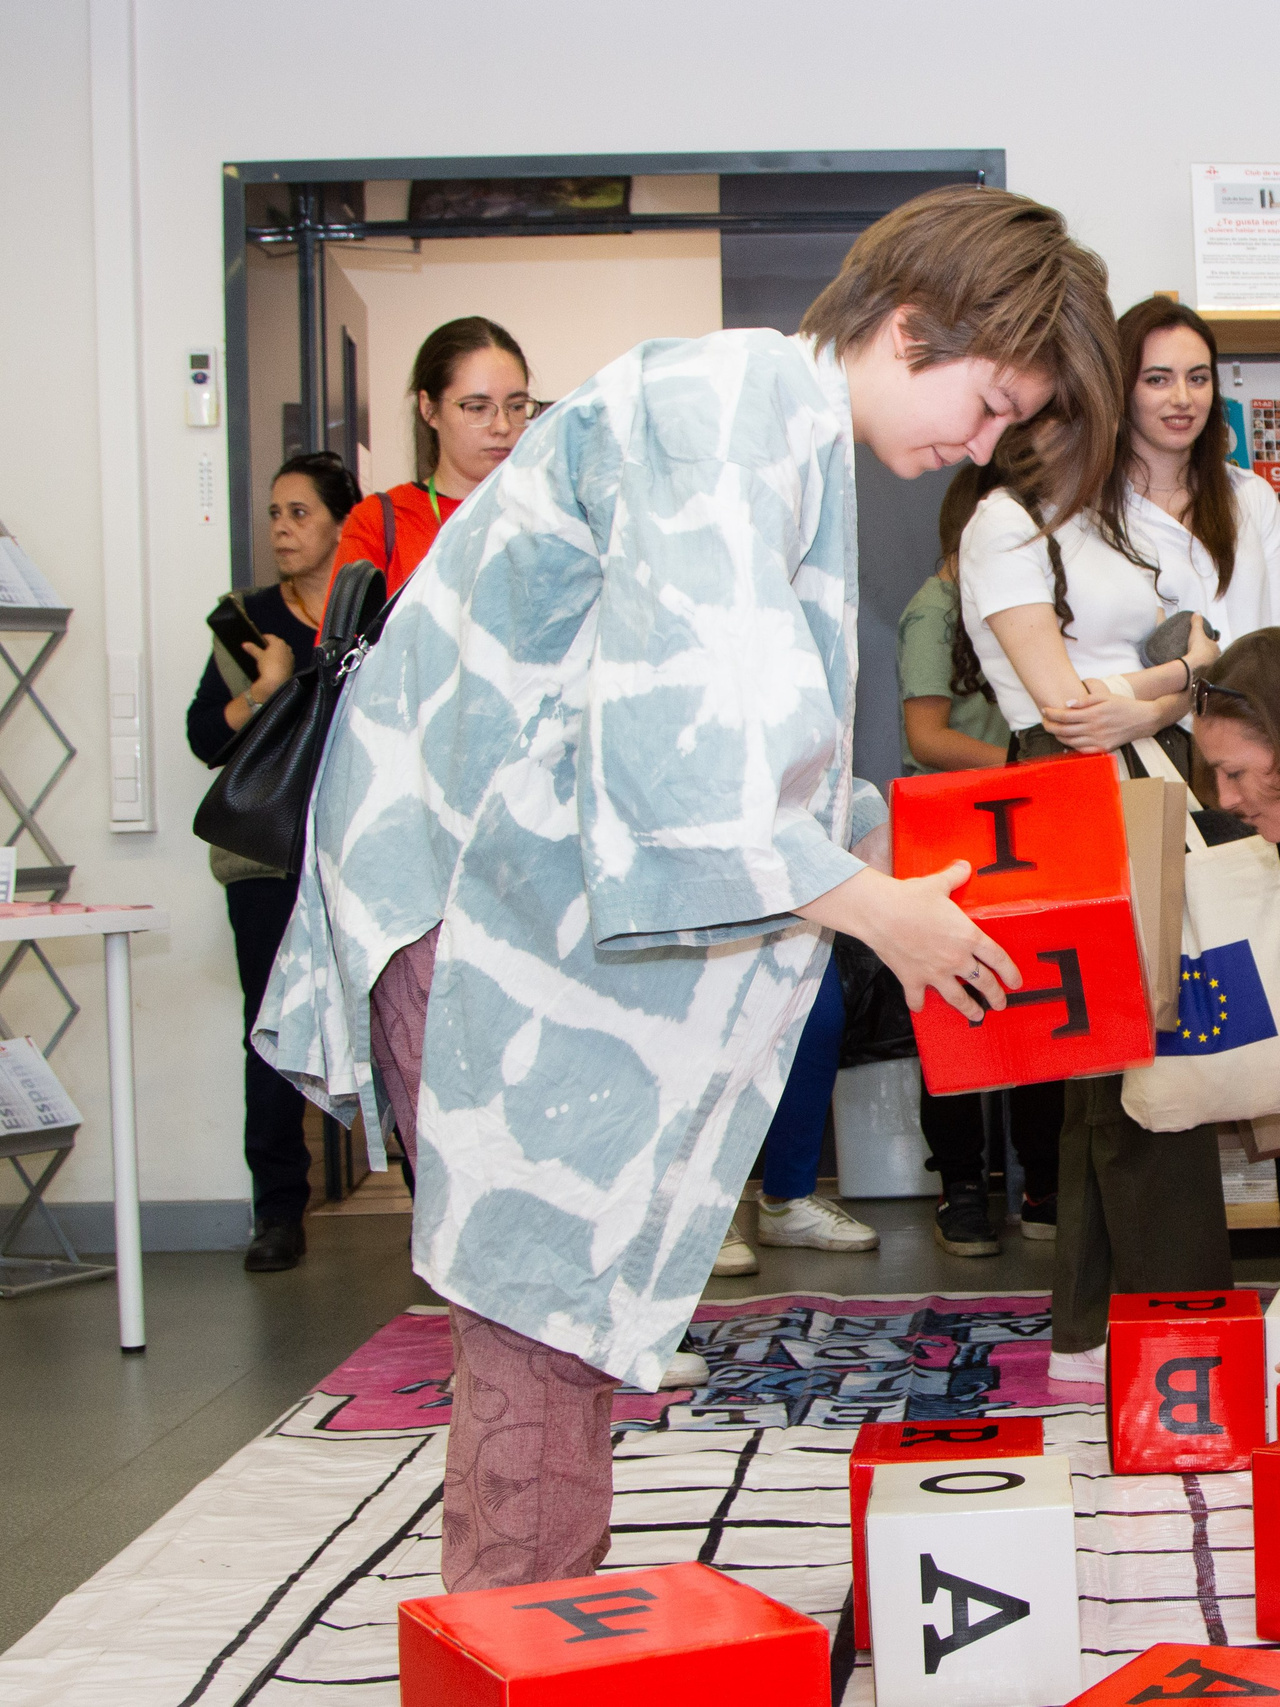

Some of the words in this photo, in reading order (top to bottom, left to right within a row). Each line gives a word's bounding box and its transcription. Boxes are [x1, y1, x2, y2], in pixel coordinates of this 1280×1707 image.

[974, 796, 1037, 877] I
[968, 947, 1091, 1040] T
[1148, 1296, 1227, 1311] P
[1155, 1356, 1225, 1435] B
[900, 1425, 999, 1448] R
[919, 1470, 1026, 1495] O
[511, 1587, 659, 1644] F
[919, 1553, 1031, 1675] A
